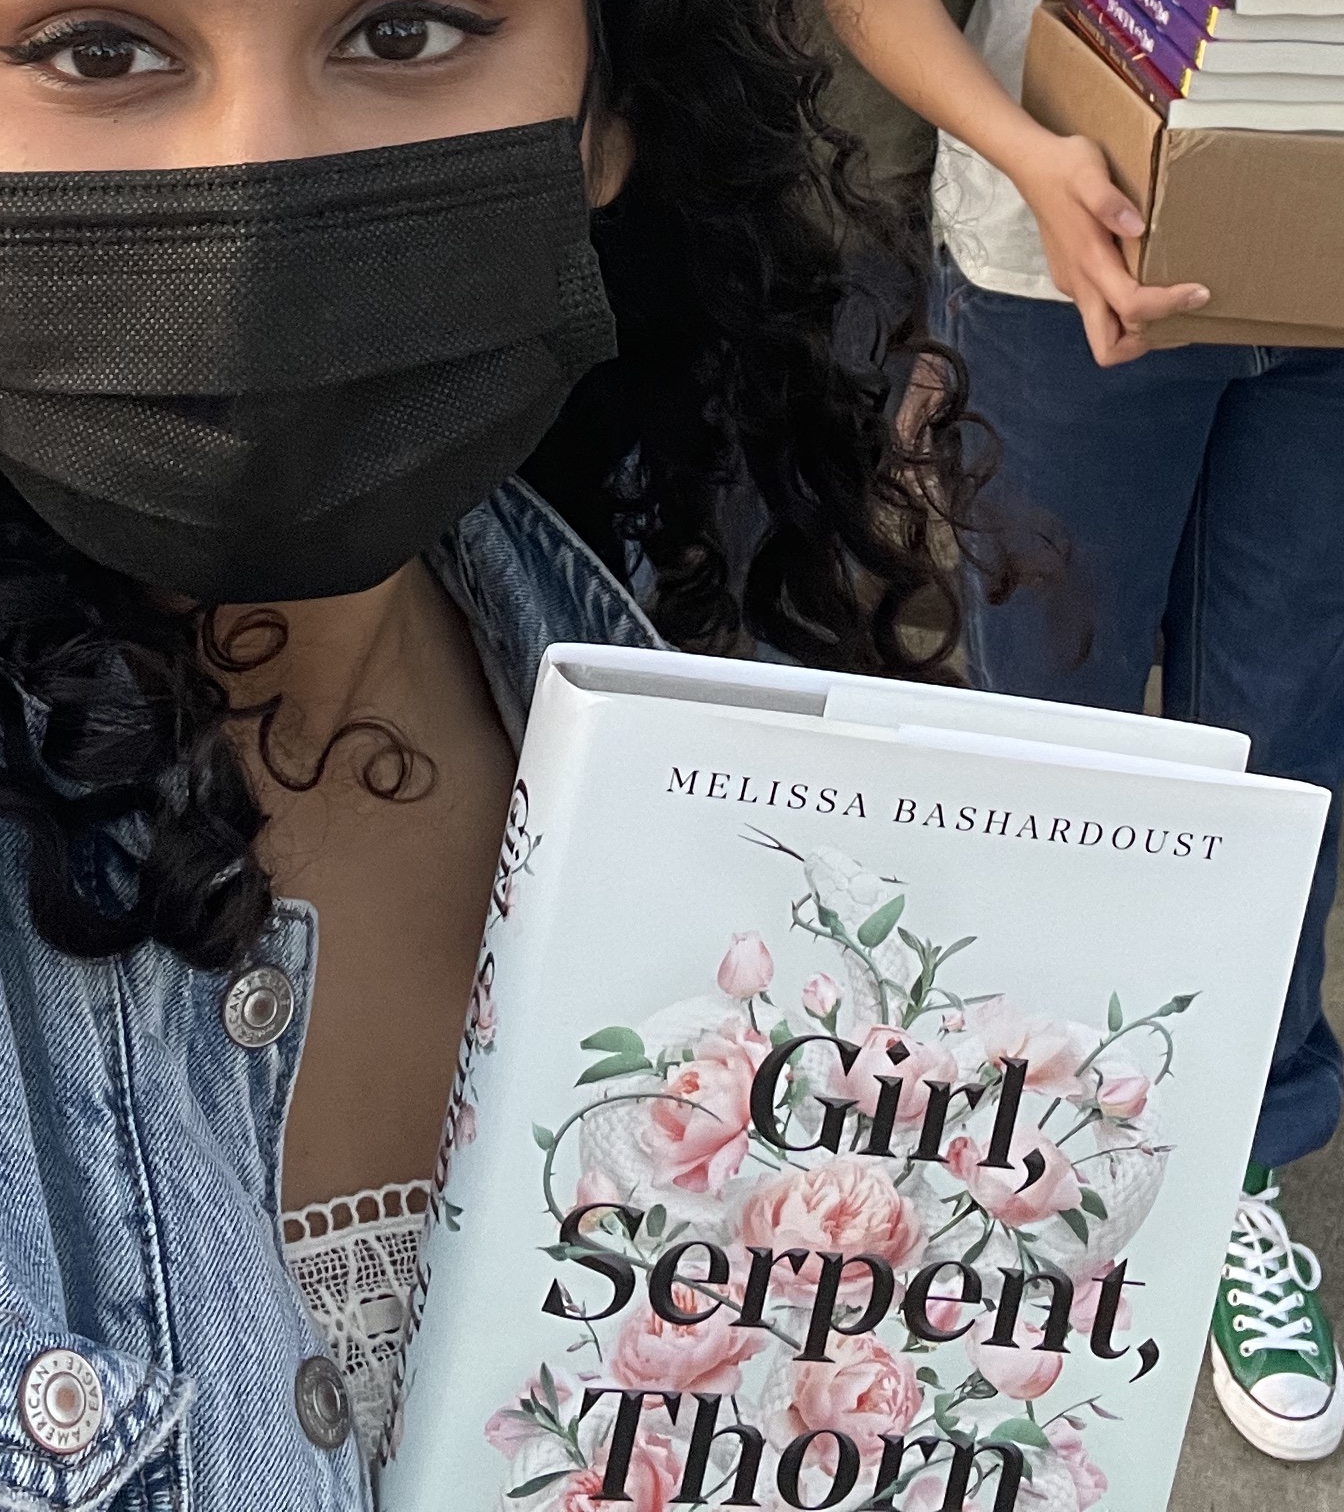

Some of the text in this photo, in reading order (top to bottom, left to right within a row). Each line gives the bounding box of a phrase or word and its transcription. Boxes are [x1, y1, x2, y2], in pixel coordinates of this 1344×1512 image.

[666, 766, 1224, 860] MELISSA BASHARDOUST
[749, 1034, 1047, 1195] Girl,
[541, 1202, 1161, 1384] Serpent,
[27, 1356, 100, 1446] AMERICAN EAGLE
[578, 1387, 1026, 1512] Thorn
